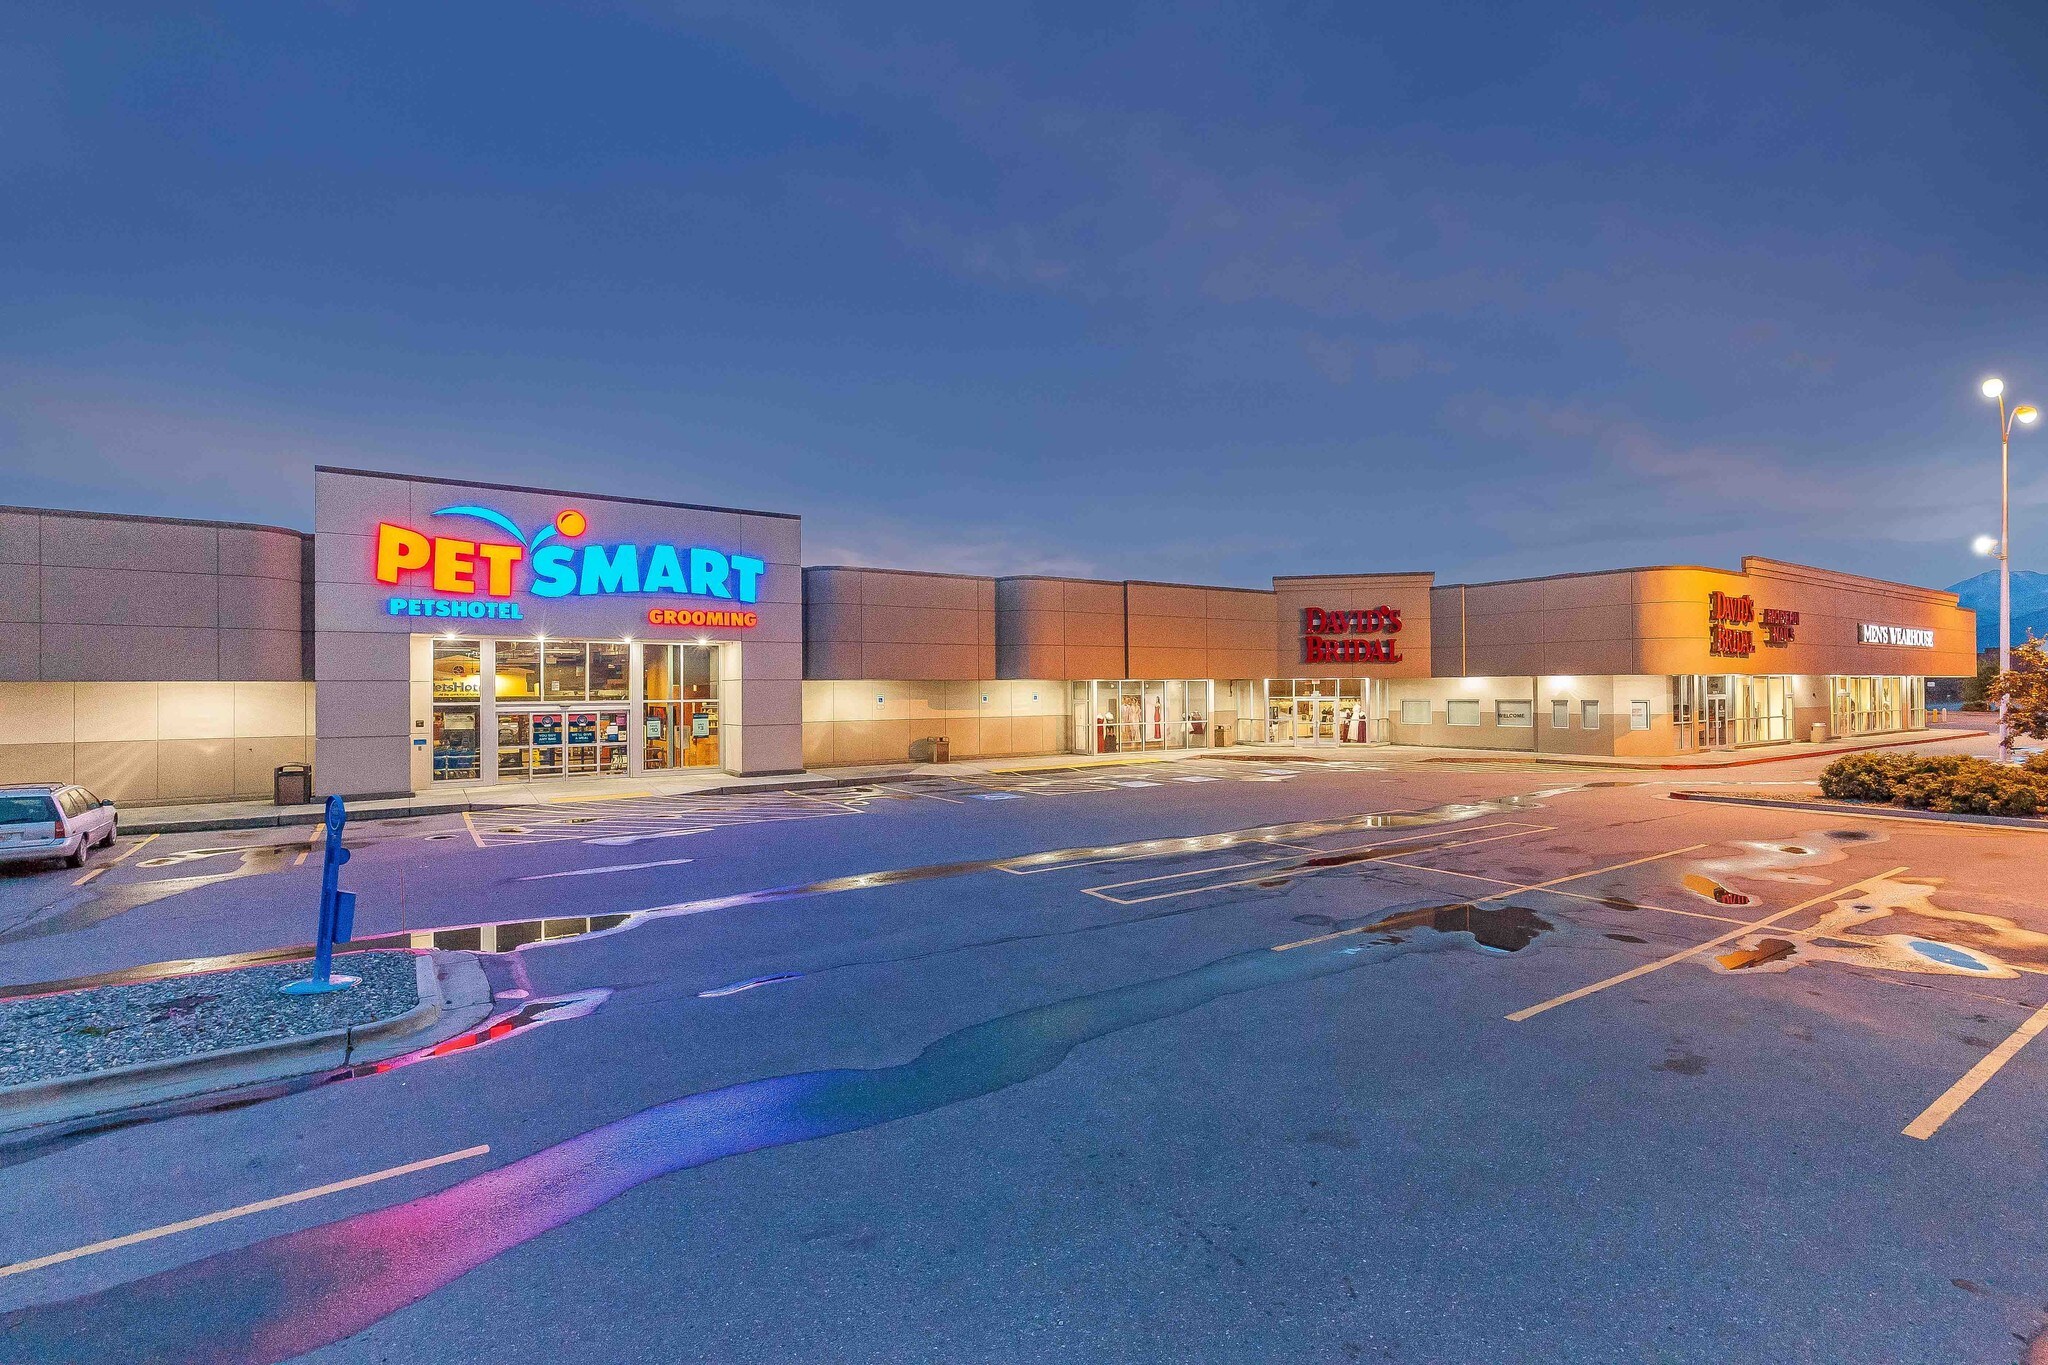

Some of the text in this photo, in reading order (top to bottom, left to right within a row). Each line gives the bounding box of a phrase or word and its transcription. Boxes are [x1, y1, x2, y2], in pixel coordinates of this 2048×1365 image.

[389, 598, 524, 620] PETSHOTEL
[648, 609, 758, 627] GROOMING
[1716, 591, 1754, 622] DAVID'S
[1304, 605, 1402, 634] DAVID'S
[1717, 624, 1755, 653] BRIDAL
[1863, 624, 1934, 647] MEN'S WEARHOUSE
[1304, 636, 1403, 663] BRIDAL
[433, 682, 481, 692] etsHot
